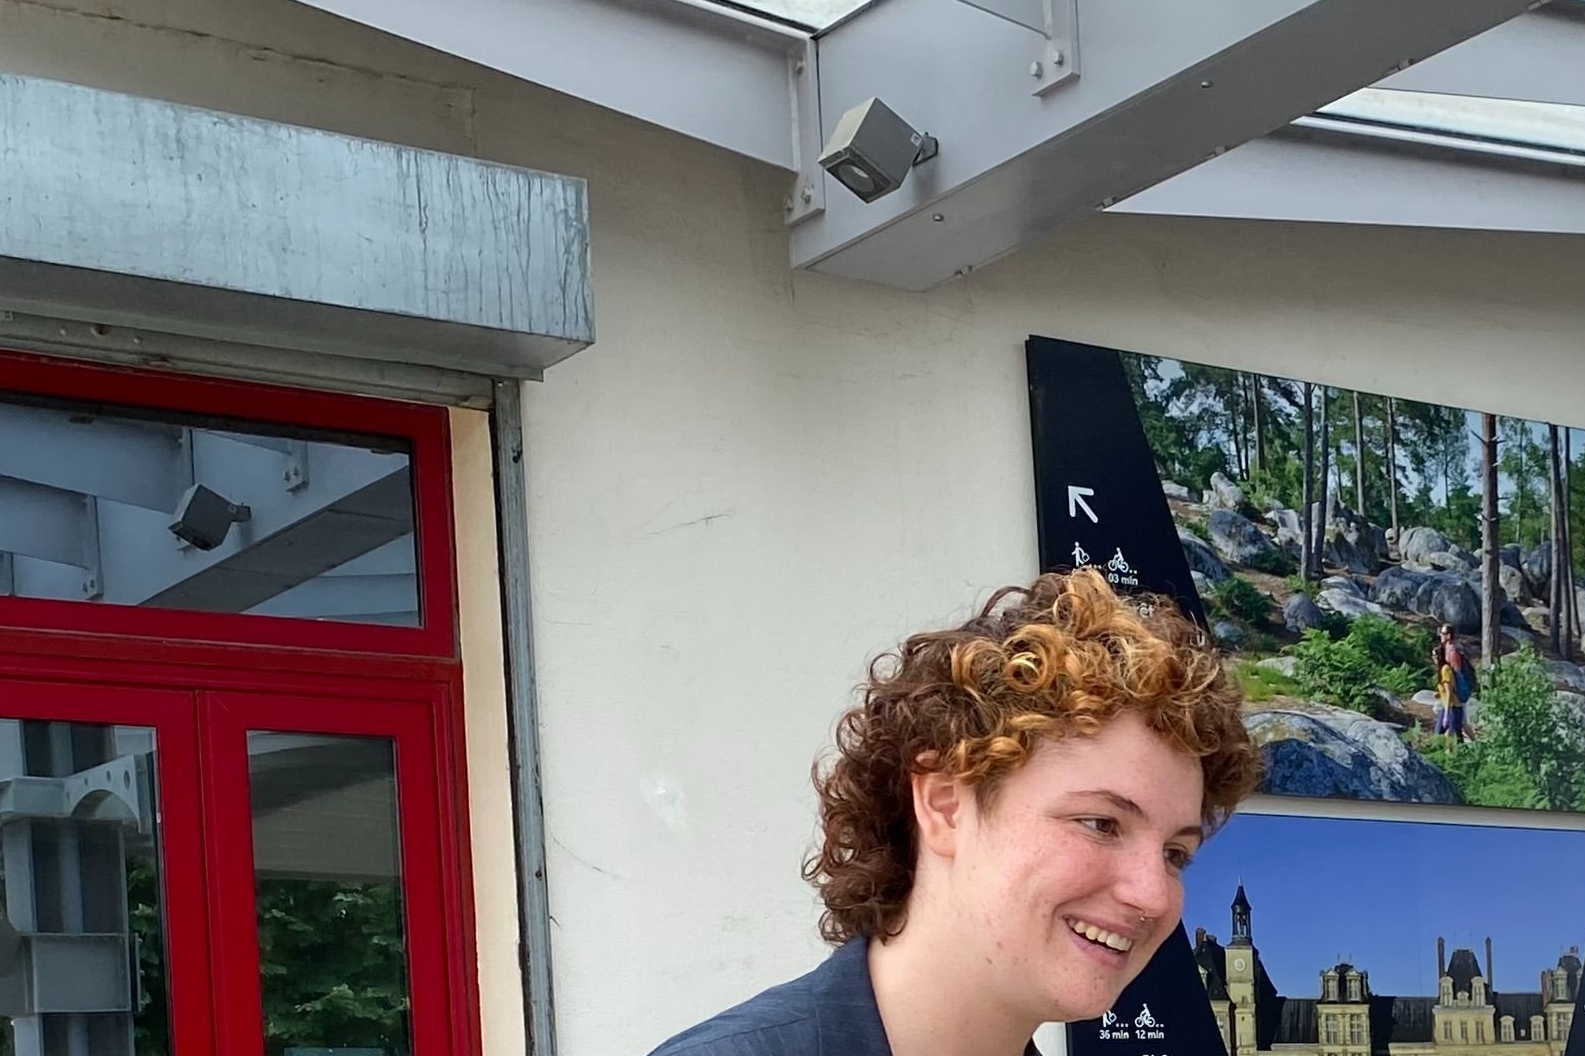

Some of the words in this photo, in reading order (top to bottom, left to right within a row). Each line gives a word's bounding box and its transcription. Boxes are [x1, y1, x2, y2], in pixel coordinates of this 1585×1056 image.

[1108, 573, 1119, 583] 03
[1121, 576, 1138, 585] min
[1100, 1030, 1110, 1039] 36
[1112, 1030, 1129, 1039] min
[1135, 1030, 1146, 1039] 12
[1148, 1030, 1164, 1039] min
